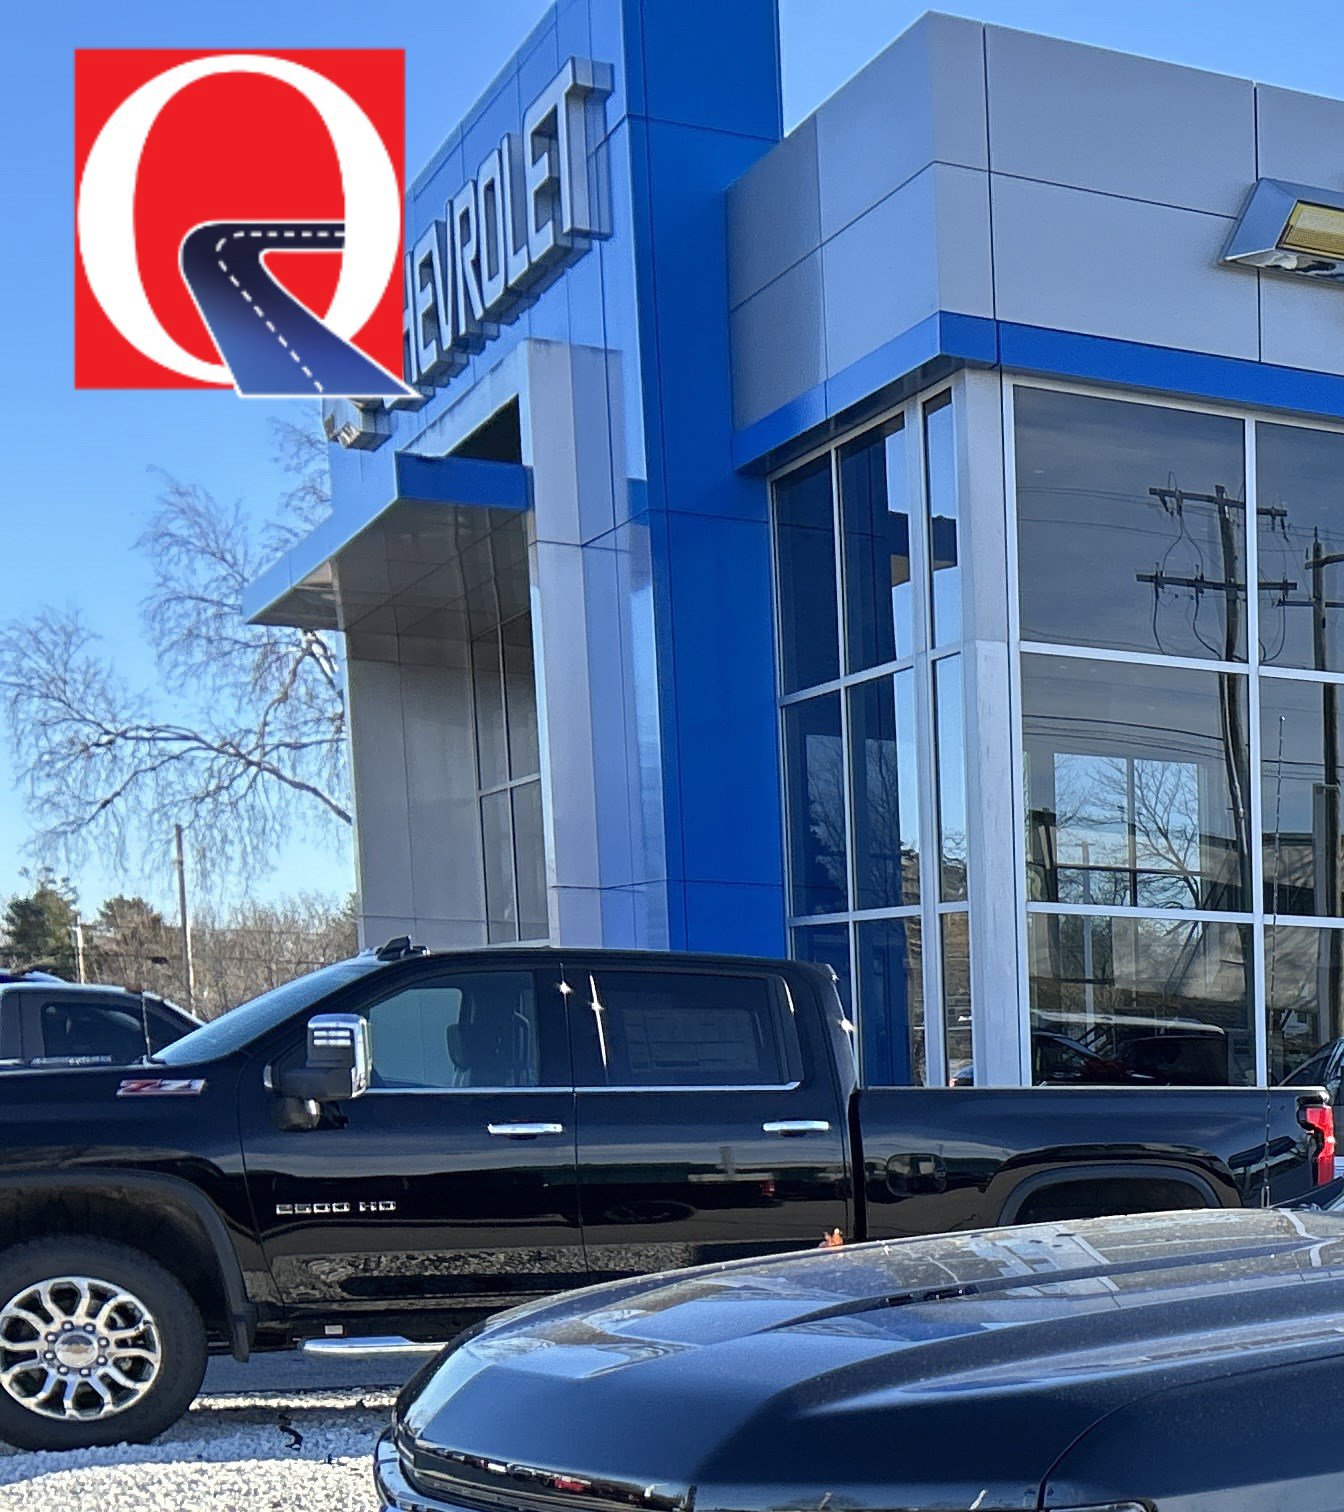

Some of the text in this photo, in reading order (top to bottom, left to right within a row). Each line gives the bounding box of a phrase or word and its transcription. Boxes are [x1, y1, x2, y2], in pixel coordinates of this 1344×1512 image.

[385, 56, 613, 410] HEVROLET
[276, 1200, 397, 1215] 2500 HD
